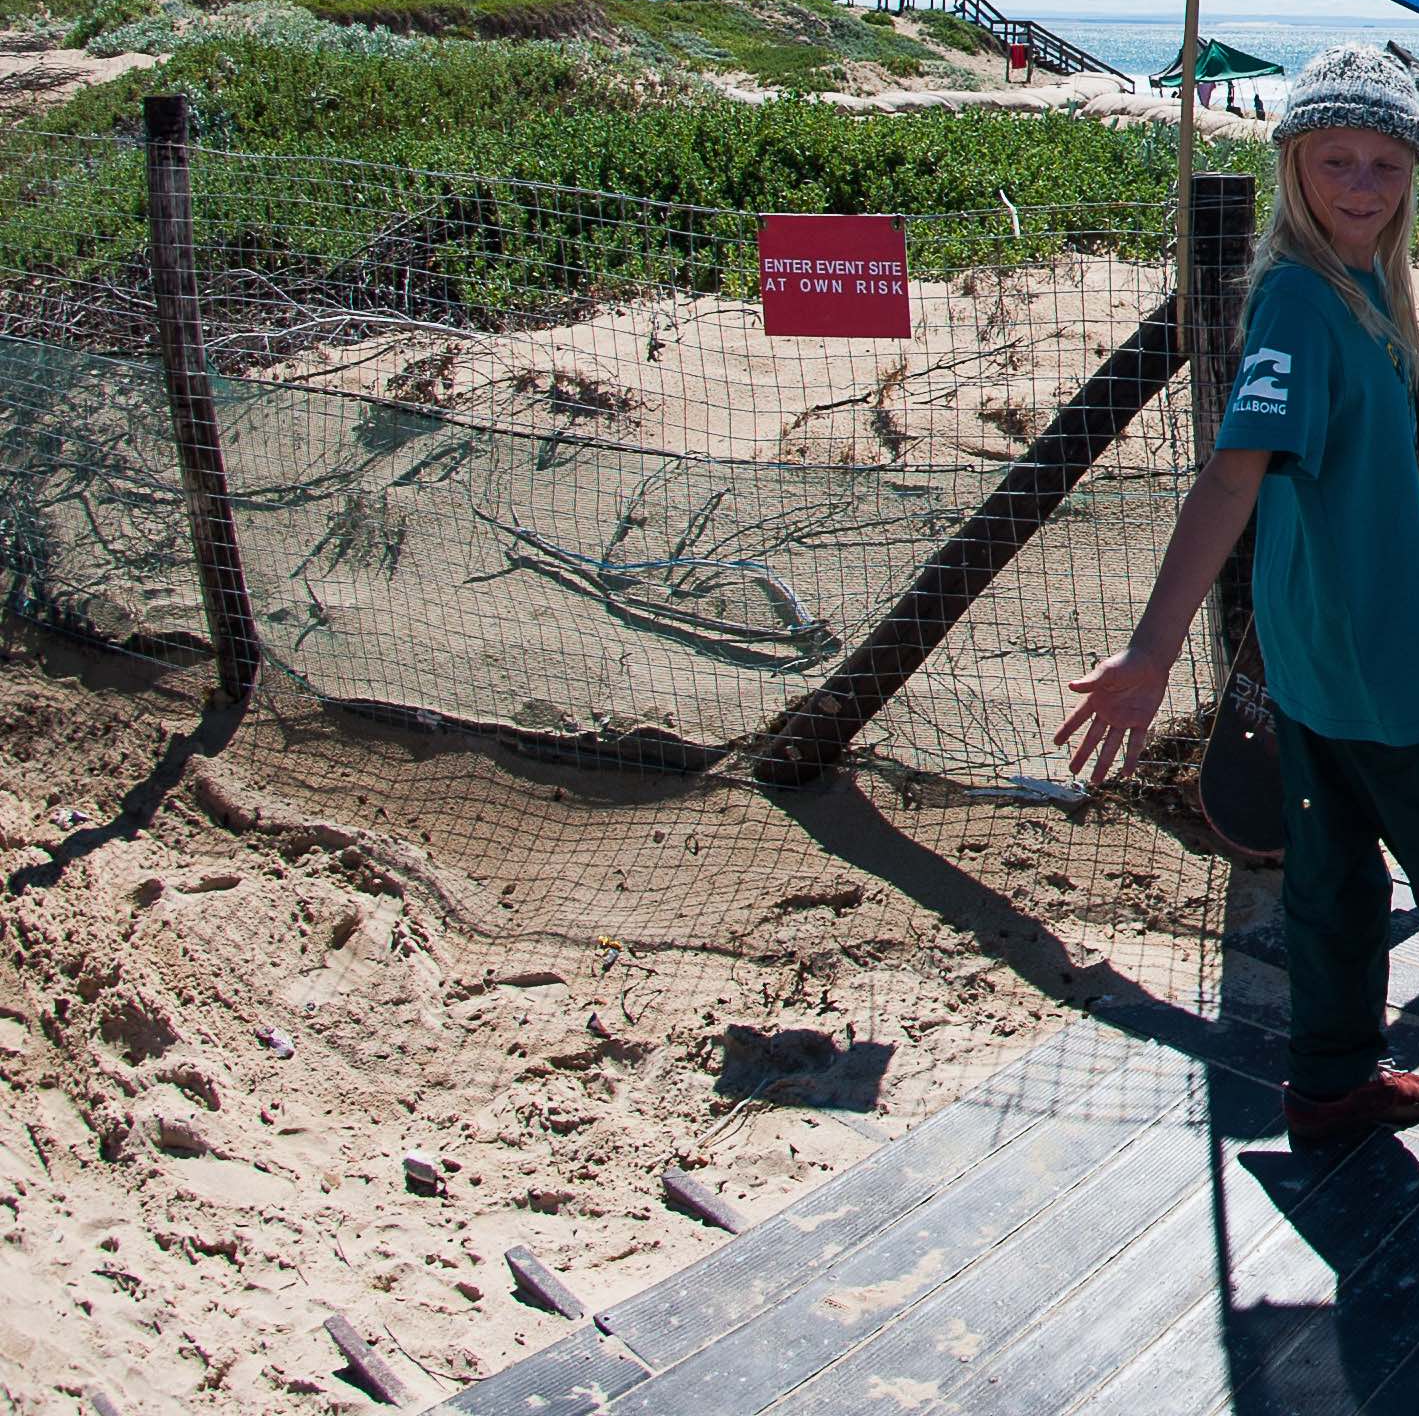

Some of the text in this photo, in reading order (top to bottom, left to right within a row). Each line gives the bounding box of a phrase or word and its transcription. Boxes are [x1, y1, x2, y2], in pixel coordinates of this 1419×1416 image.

[764, 259, 902, 276] ENTER EVENT SITE
[765, 278, 903, 295] AT OWN RISK
